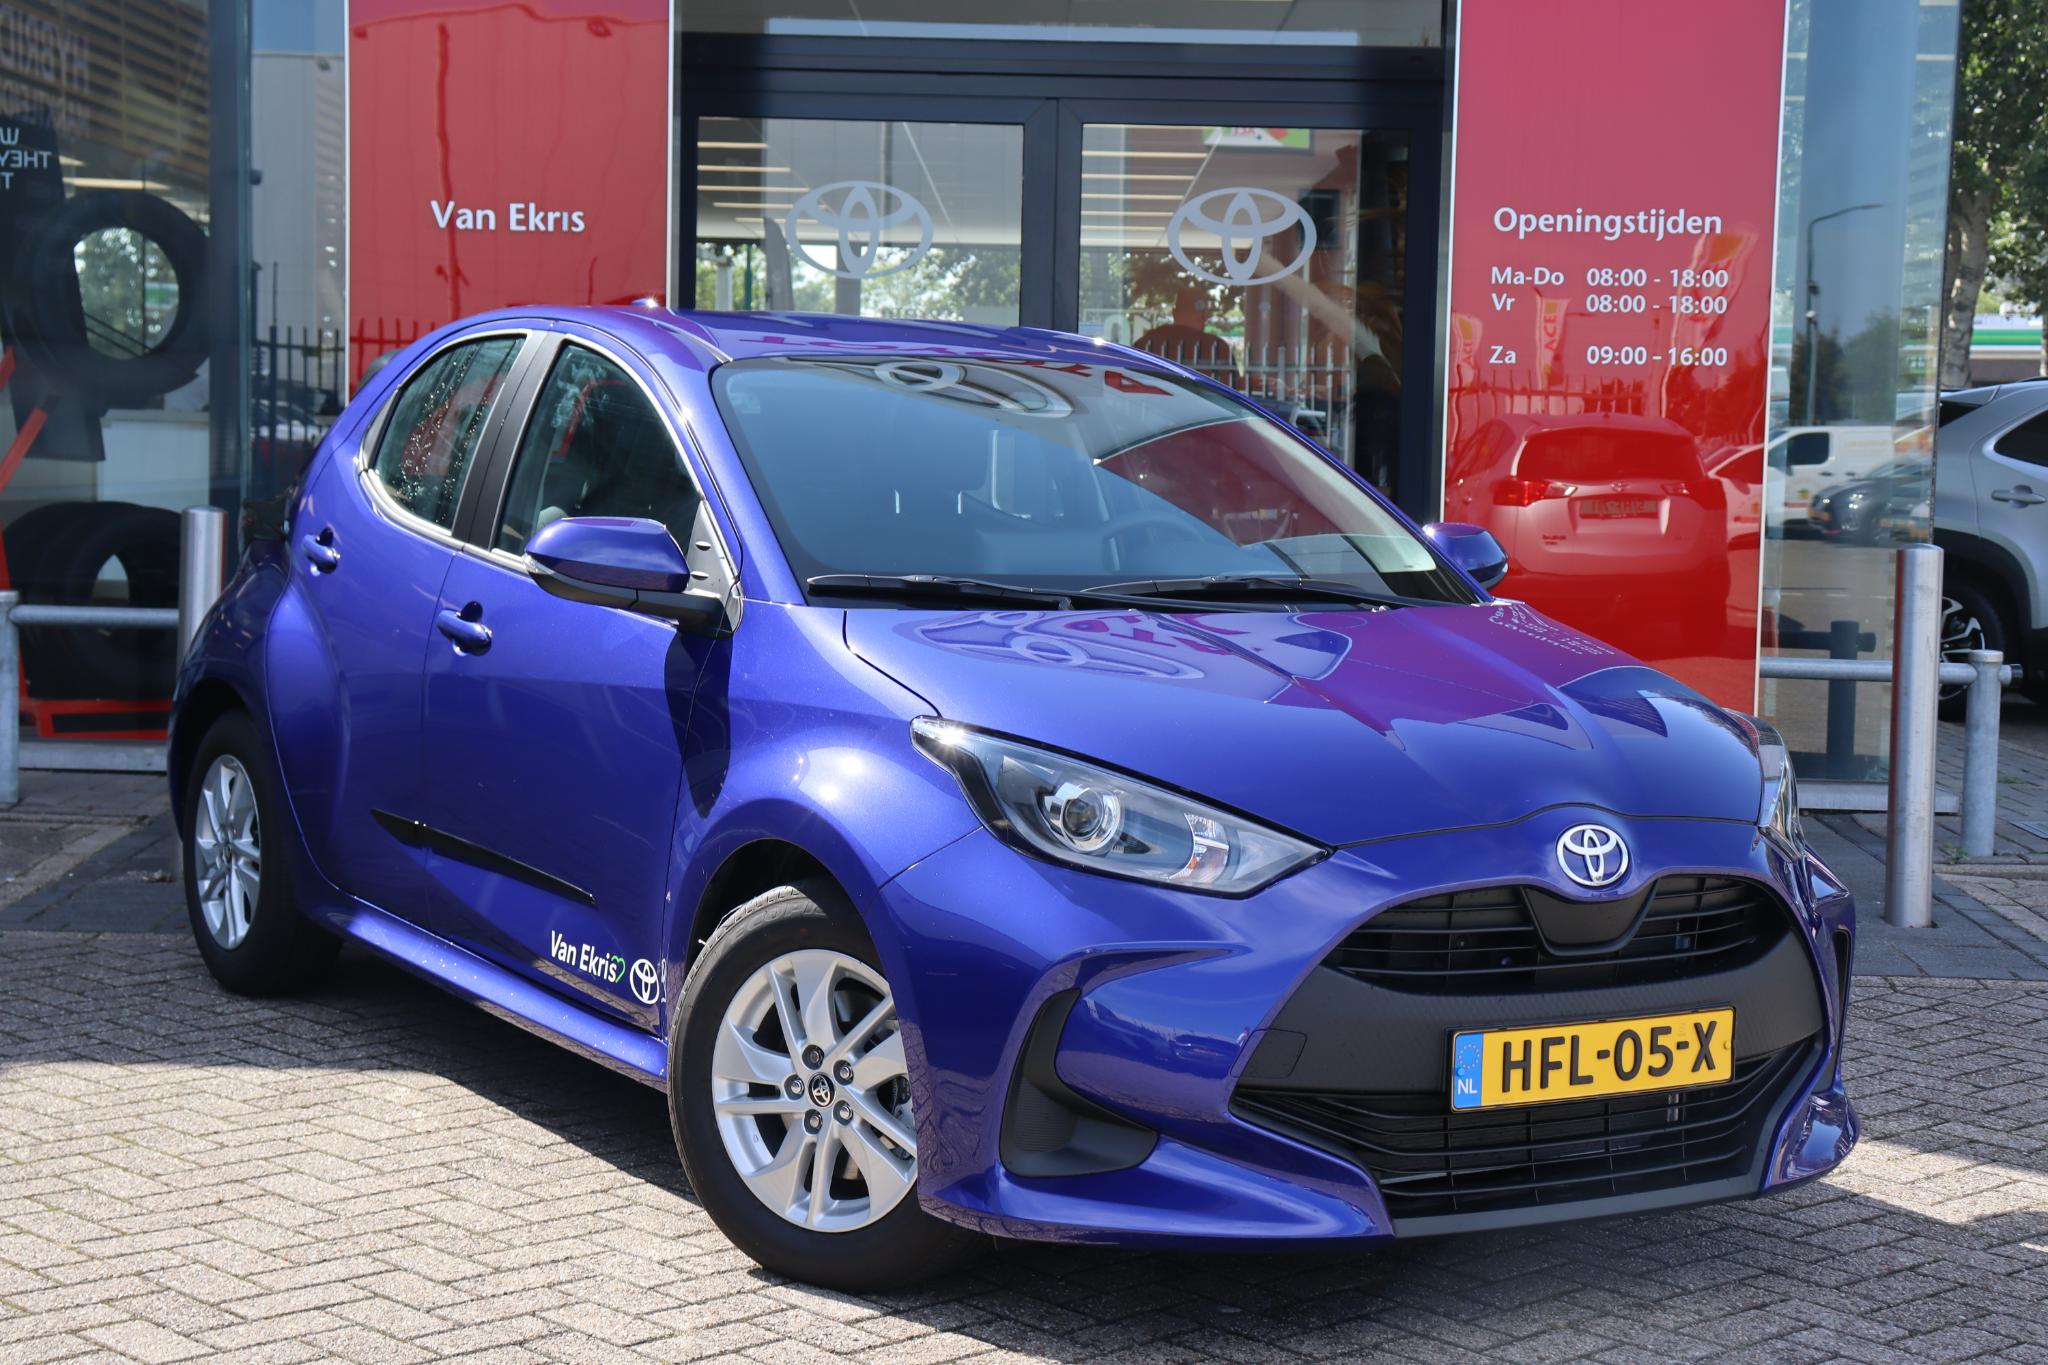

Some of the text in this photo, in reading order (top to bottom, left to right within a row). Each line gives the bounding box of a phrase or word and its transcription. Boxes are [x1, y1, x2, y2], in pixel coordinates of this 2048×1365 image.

[430, 200, 585, 232] Van Ekris
[1493, 206, 1722, 241] Openingstijden
[1491, 266, 1565, 286] Ma-Do
[1586, 268, 1648, 288] 08:00
[1670, 269, 1729, 288] 18:00
[1491, 293, 1515, 311] Vr
[1585, 294, 1646, 313] 08:00
[1669, 295, 1728, 314] 18:00
[1489, 346, 1517, 364] Za
[1586, 346, 1648, 366] 09:00
[1668, 347, 1728, 366] 16:00
[551, 930, 617, 982] Van Ekris
[1502, 1020, 1717, 1094] HFL-05-X
[1457, 1078, 1477, 1095] NL
